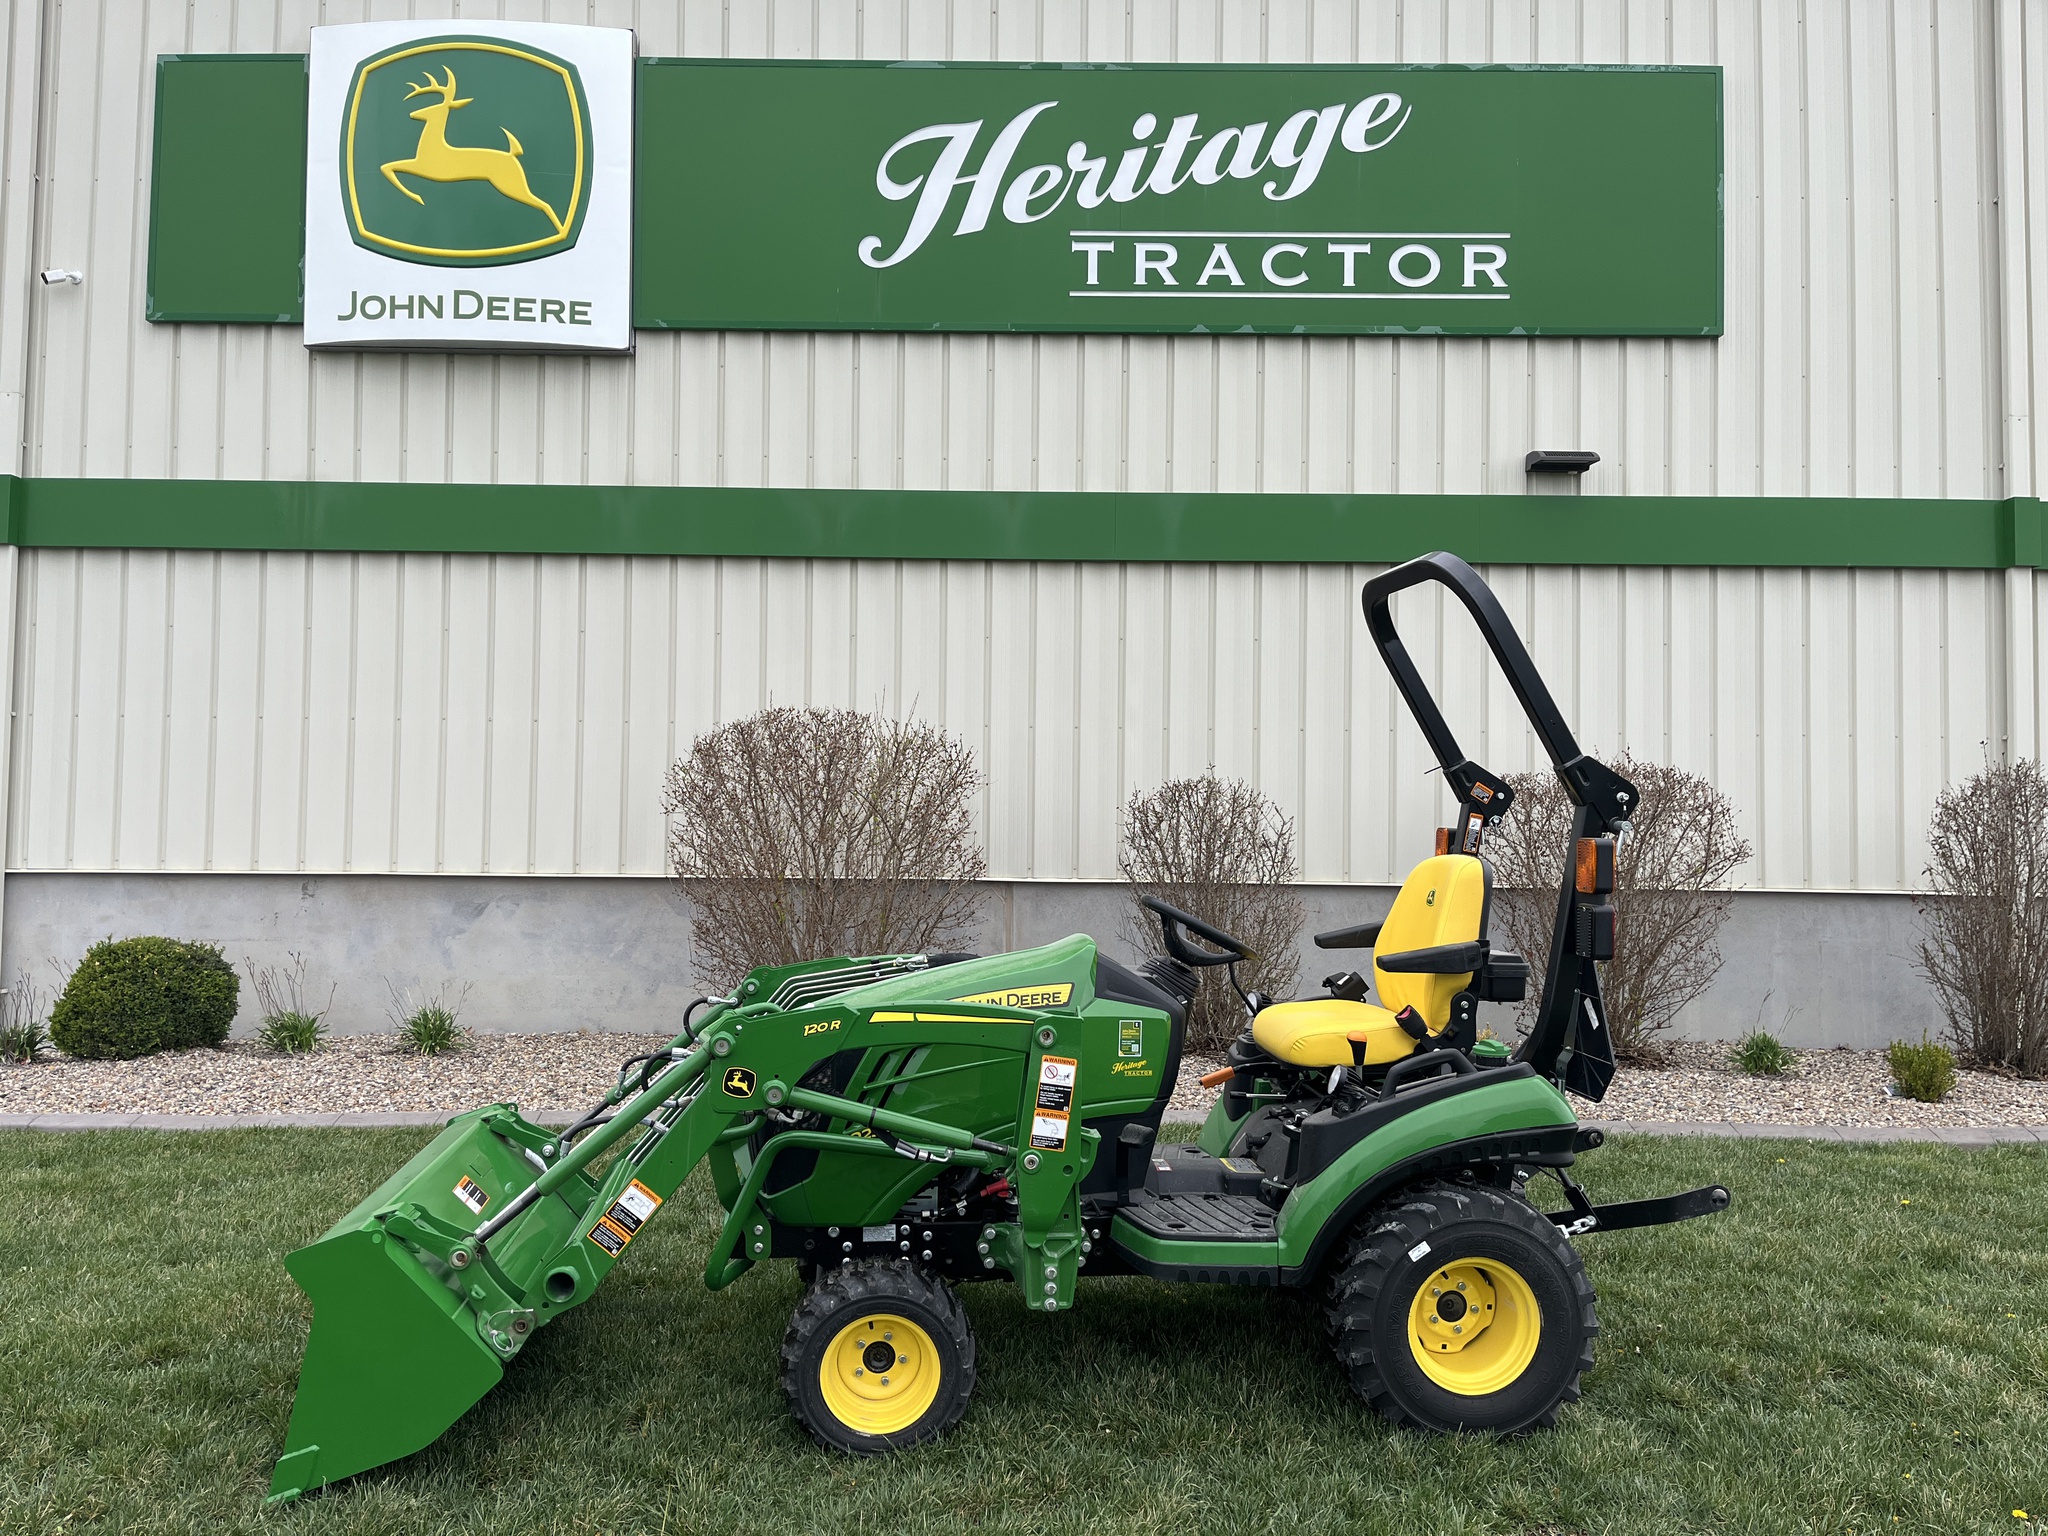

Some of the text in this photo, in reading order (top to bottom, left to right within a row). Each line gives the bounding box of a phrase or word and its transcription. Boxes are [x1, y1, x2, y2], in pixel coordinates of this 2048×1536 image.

[858, 92, 1412, 270] Heritage
[1070, 242, 1509, 289] TRACTOR
[337, 289, 592, 326] JOHN DEERE
[1007, 991, 1062, 1007] DEERE
[803, 1022, 829, 1037] 120
[1049, 1056, 1075, 1065] WARNING
[1111, 1059, 1147, 1075] Heritage
[1041, 1112, 1067, 1120] WARNING
[639, 1184, 658, 1202] WARNING
